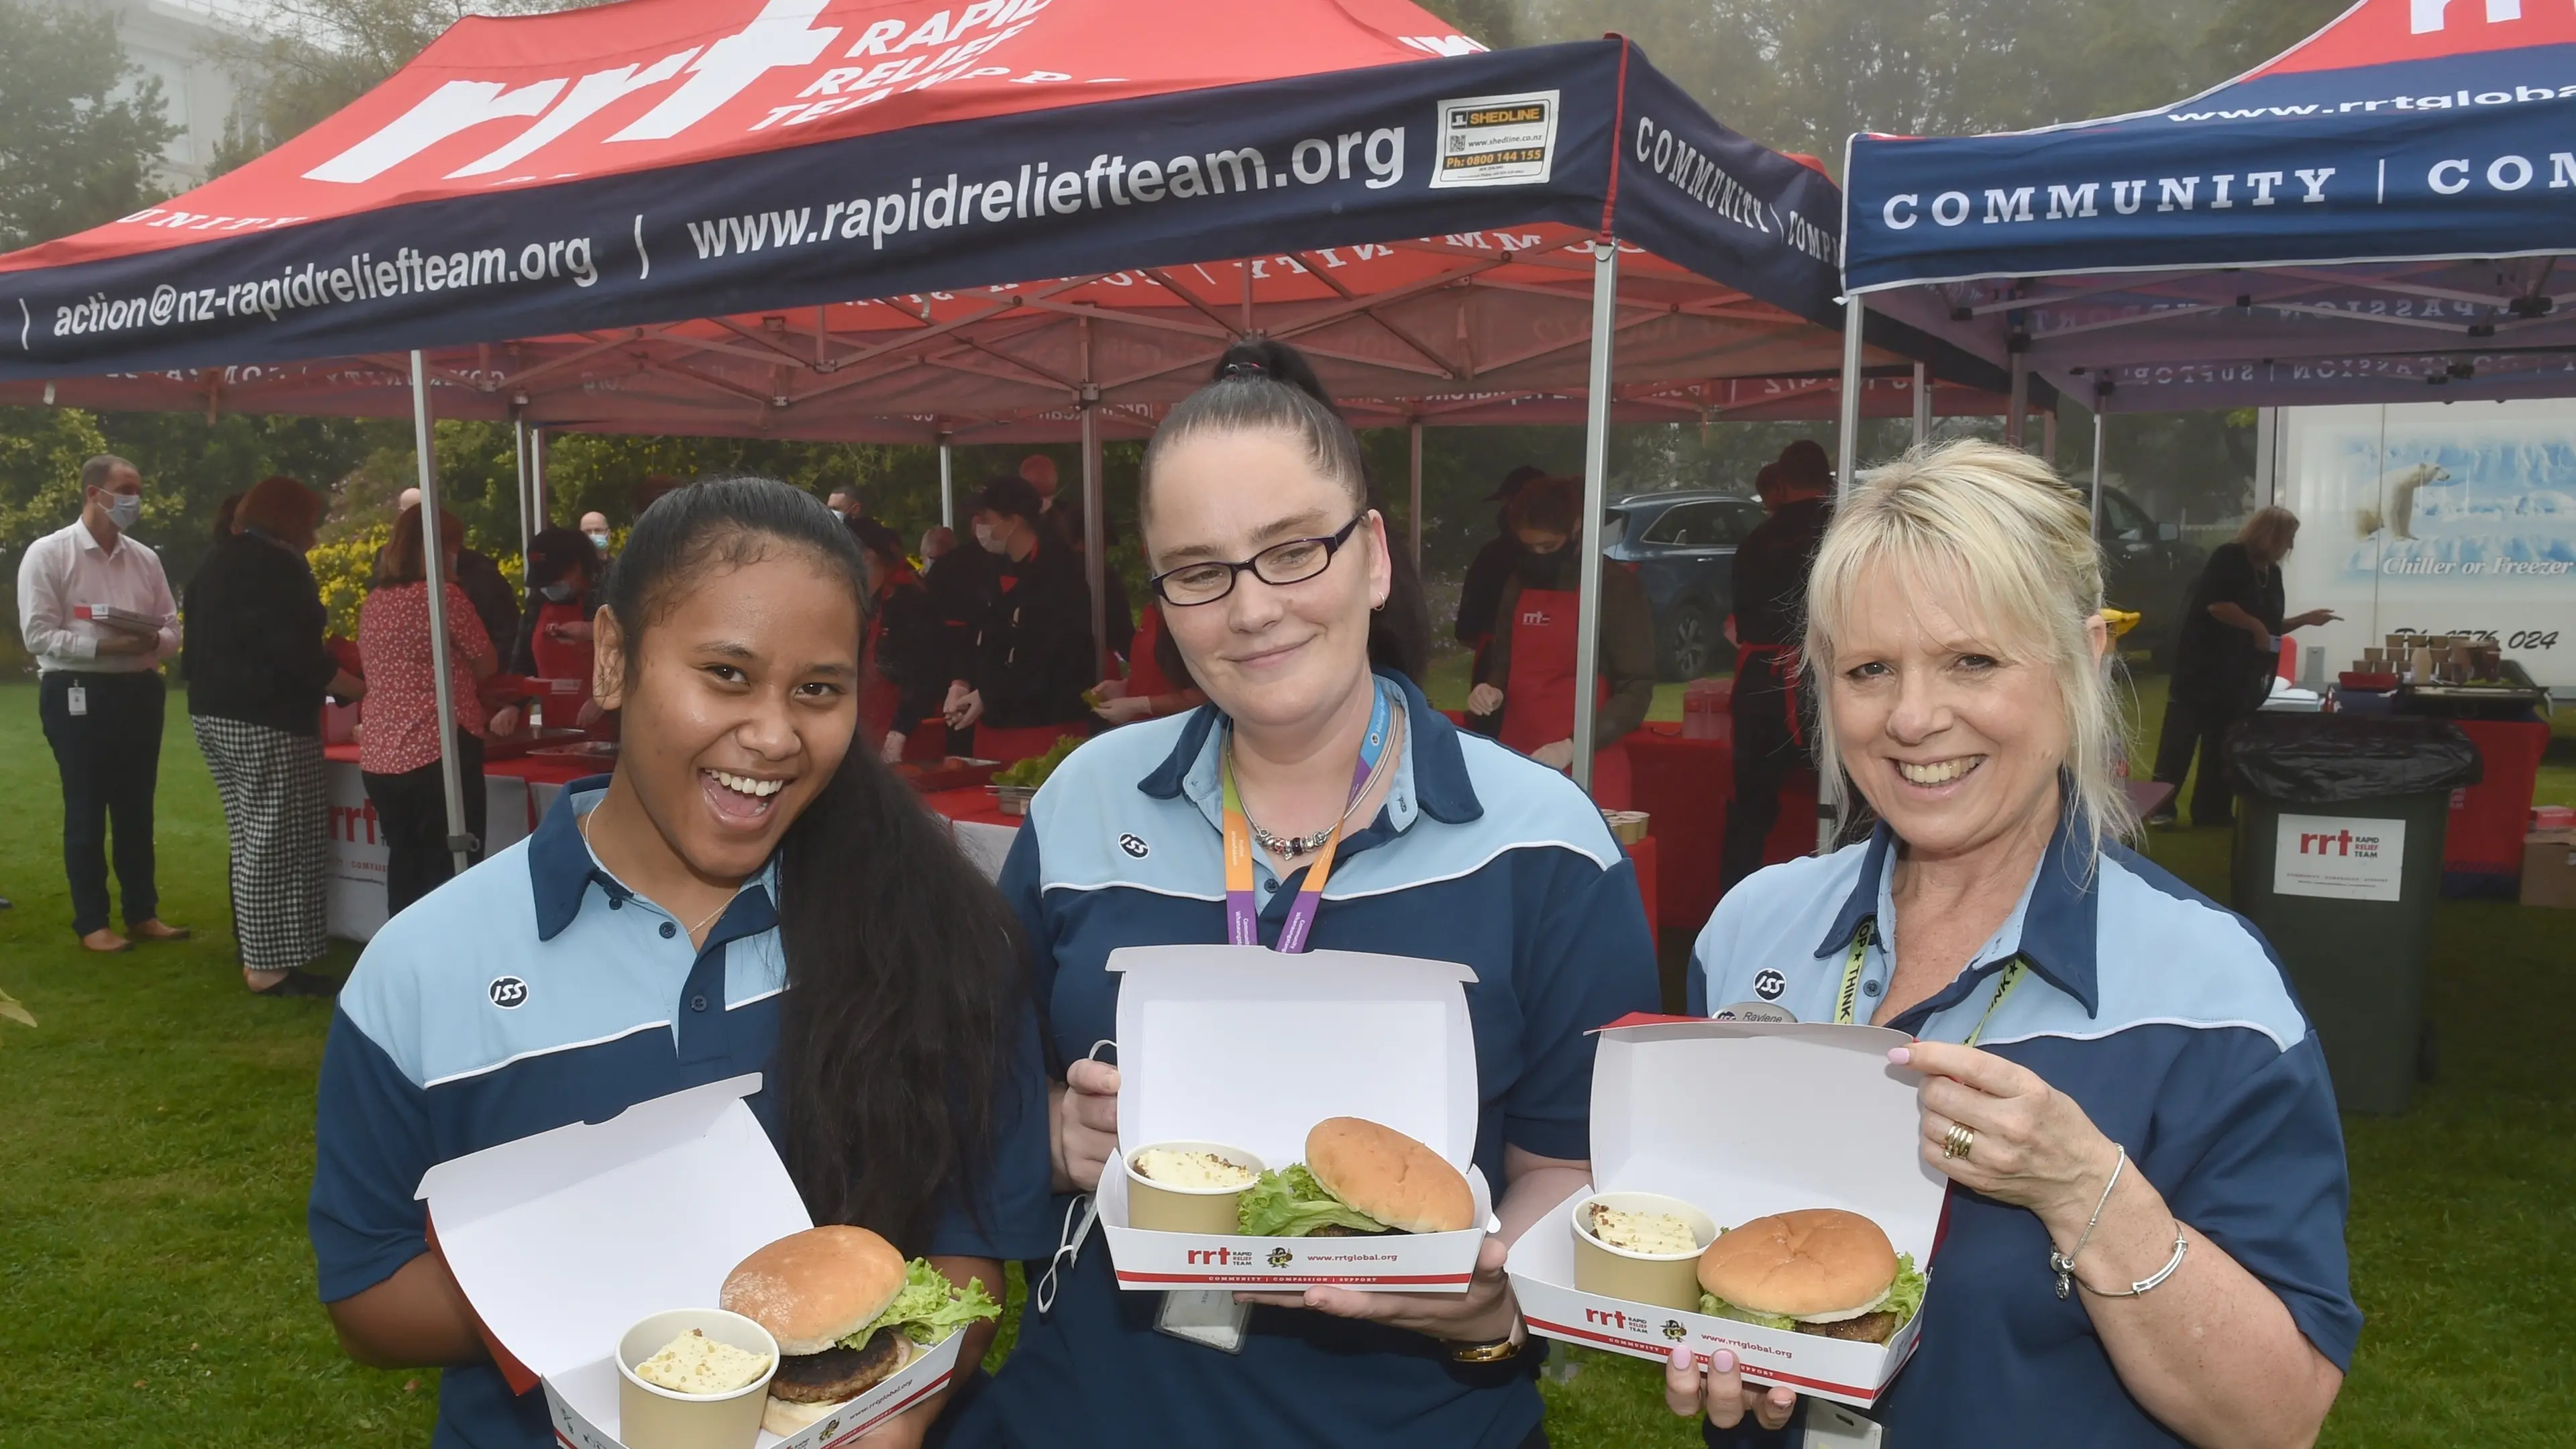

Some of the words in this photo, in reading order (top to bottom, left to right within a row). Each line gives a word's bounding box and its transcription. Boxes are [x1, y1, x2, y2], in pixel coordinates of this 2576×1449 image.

[795, 16, 1038, 99] RELIEF
[301, 0, 843, 183] rrt
[1470, 107, 1540, 125] SHEDLINE
[1468, 134, 1542, 148] www.shedline.co.nz
[1446, 157, 1465, 168] Ph:
[1466, 154, 1493, 166] 0800
[1497, 152, 1517, 164] 144
[1521, 150, 1542, 161] 155
[1636, 117, 1770, 233] COMMUNITY
[687, 126, 1405, 260] www.rapidreliefteam.org
[1883, 167, 2336, 231] COMMUNITY
[115, 209, 308, 230] UNITY
[53, 237, 597, 337] action@nz-rapidreliefteam.org
[2383, 556, 2457, 575] Chiller
[2461, 561, 2486, 575] or
[2493, 556, 2574, 576] Freezer
[2508, 631, 2559, 650] 024
[329, 798, 377, 845] rrt
[2300, 829, 2353, 856] rrt
[1840, 965, 1860, 1021] THINK
[1187, 1247, 1230, 1265] rrt
[1307, 1254, 1398, 1263] www.rrtglobal.org
[1585, 1307, 1626, 1330] rrt
[1609, 1338, 1660, 1352] COMMUNITY
[1740, 1365, 1774, 1377] UPPORT
[1701, 1333, 1792, 1359] www.rrtglobal.org
